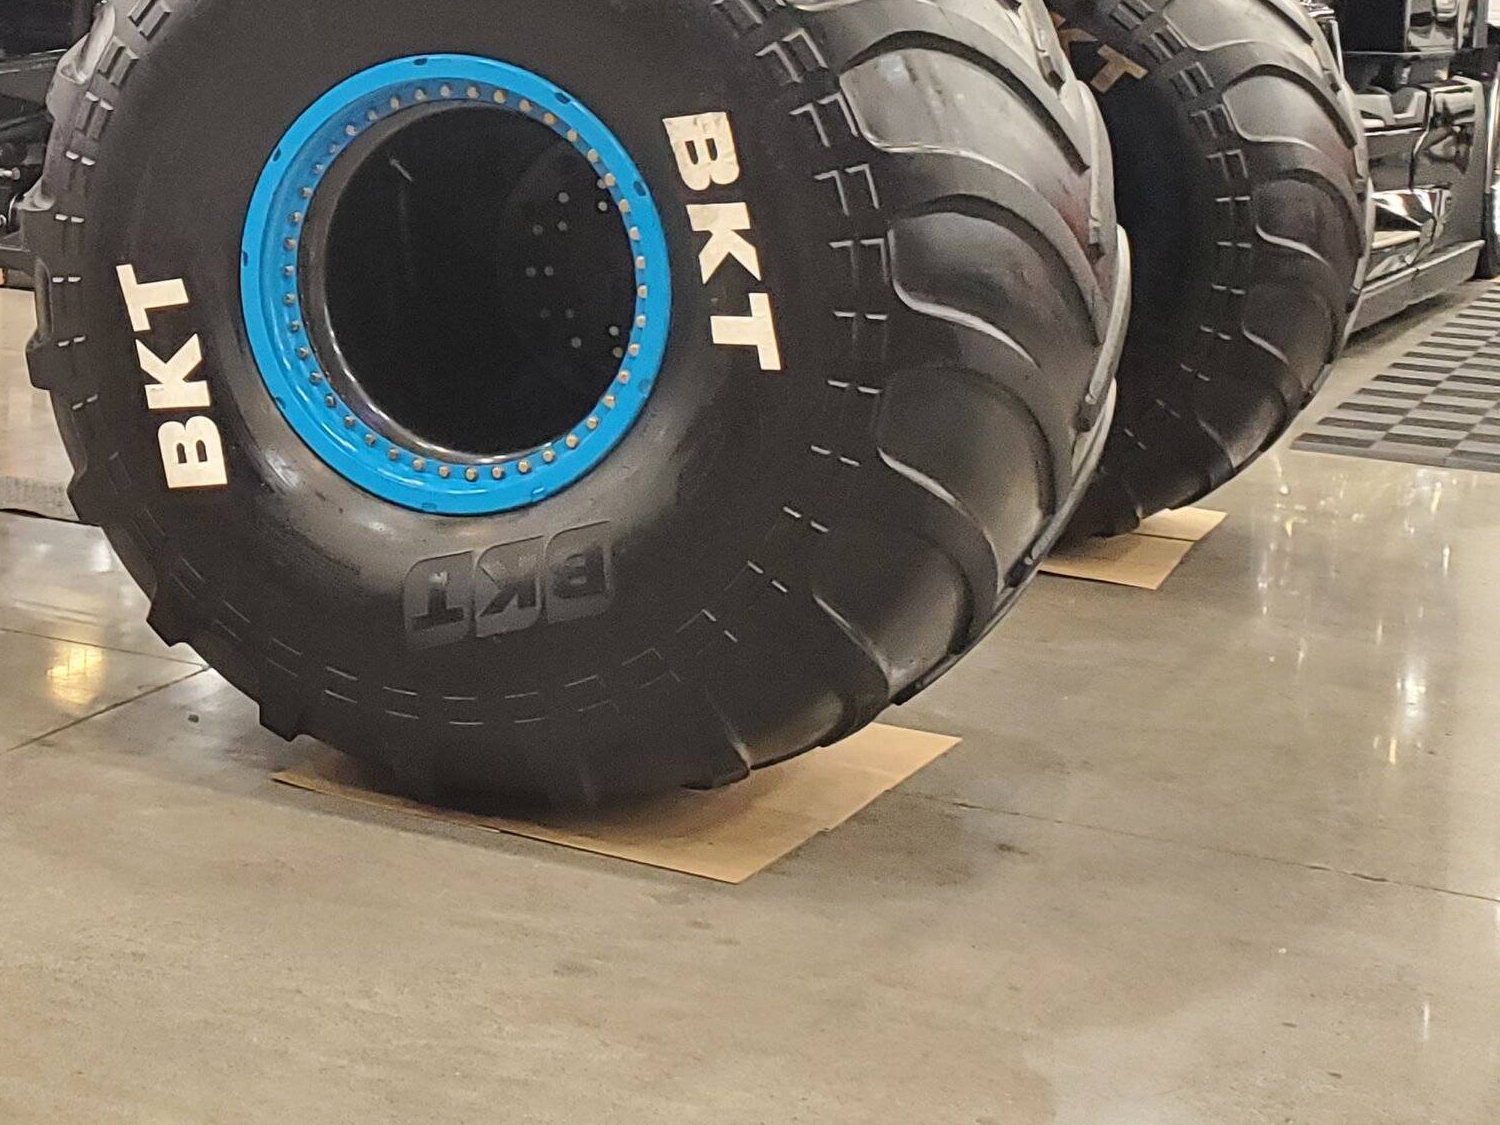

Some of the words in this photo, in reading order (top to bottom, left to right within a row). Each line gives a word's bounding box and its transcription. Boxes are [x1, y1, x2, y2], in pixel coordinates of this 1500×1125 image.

[662, 111, 782, 371] BKT
[116, 263, 228, 489] BKT
[403, 527, 612, 645] BKT
